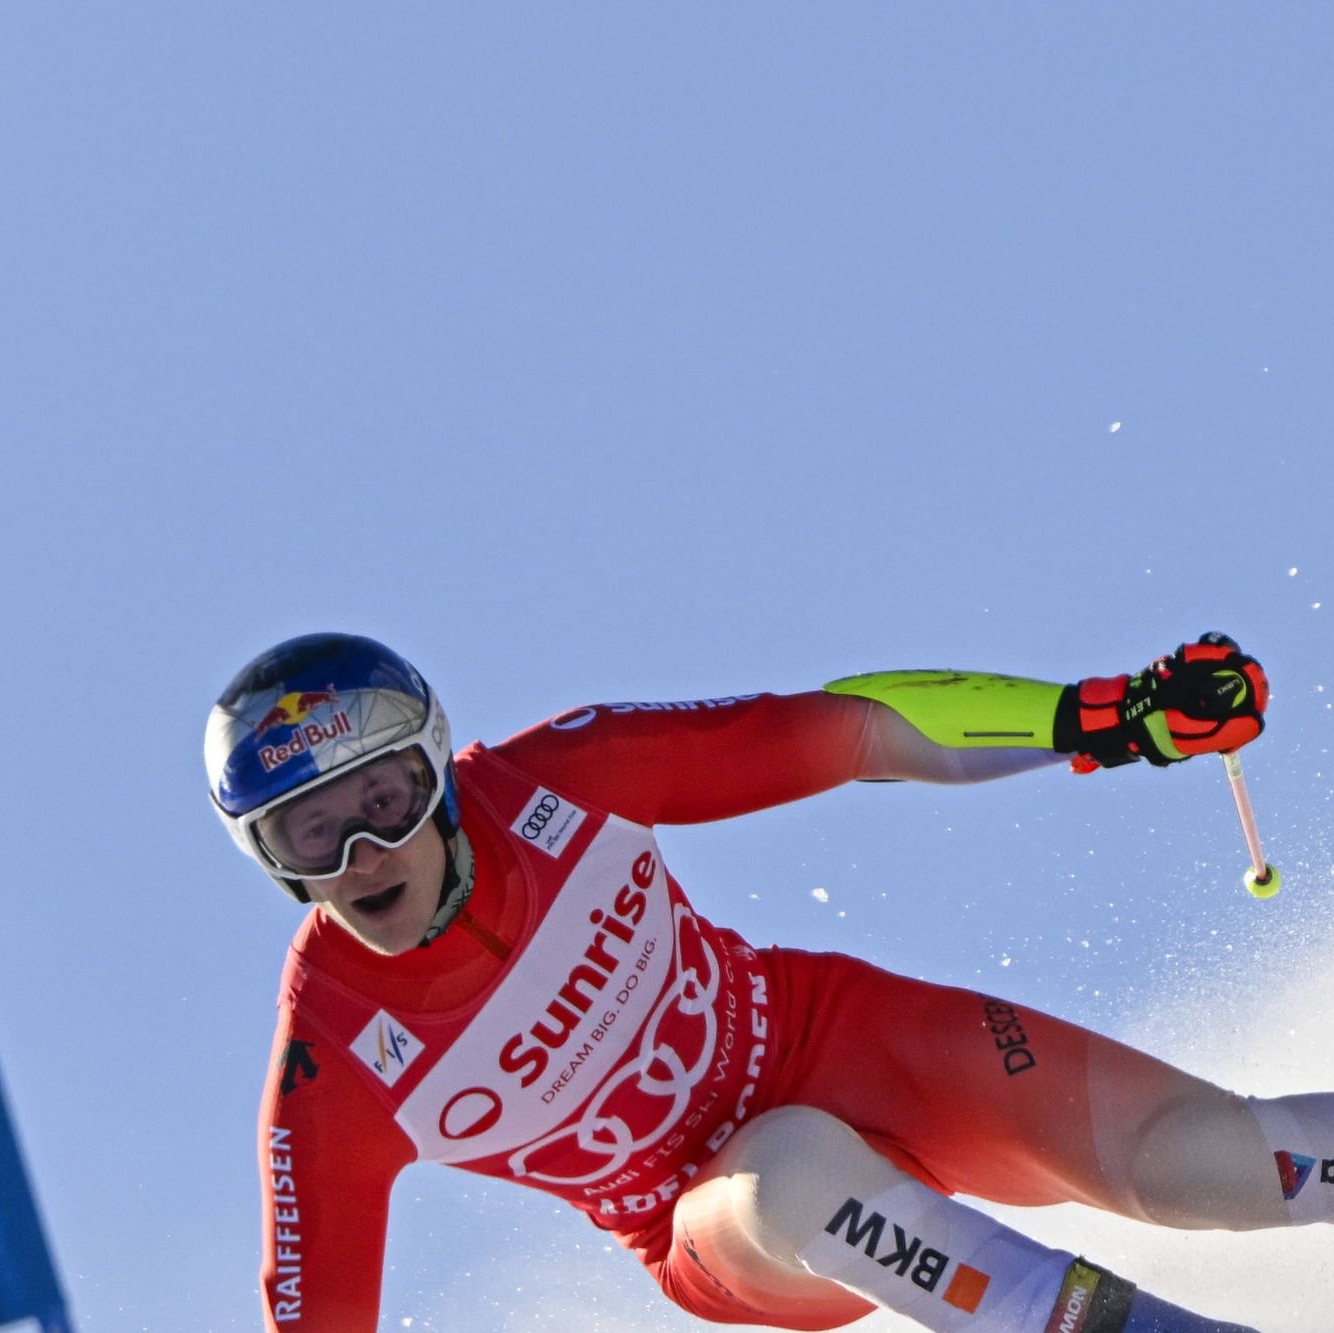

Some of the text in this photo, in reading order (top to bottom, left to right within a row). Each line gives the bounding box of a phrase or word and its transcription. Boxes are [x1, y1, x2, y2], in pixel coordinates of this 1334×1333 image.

[259, 711, 352, 771] Red Bull
[1125, 696, 1152, 720] LEKI
[499, 850, 656, 1088] Sunrise
[541, 937, 657, 1104] DREAM BIG. DO BIG.
[373, 1031, 408, 1074] FIS
[584, 990, 737, 1197] Audi FIS Ski World
[269, 1126, 302, 1322] RAIFFEISEN
[824, 1197, 949, 1293] BKW
